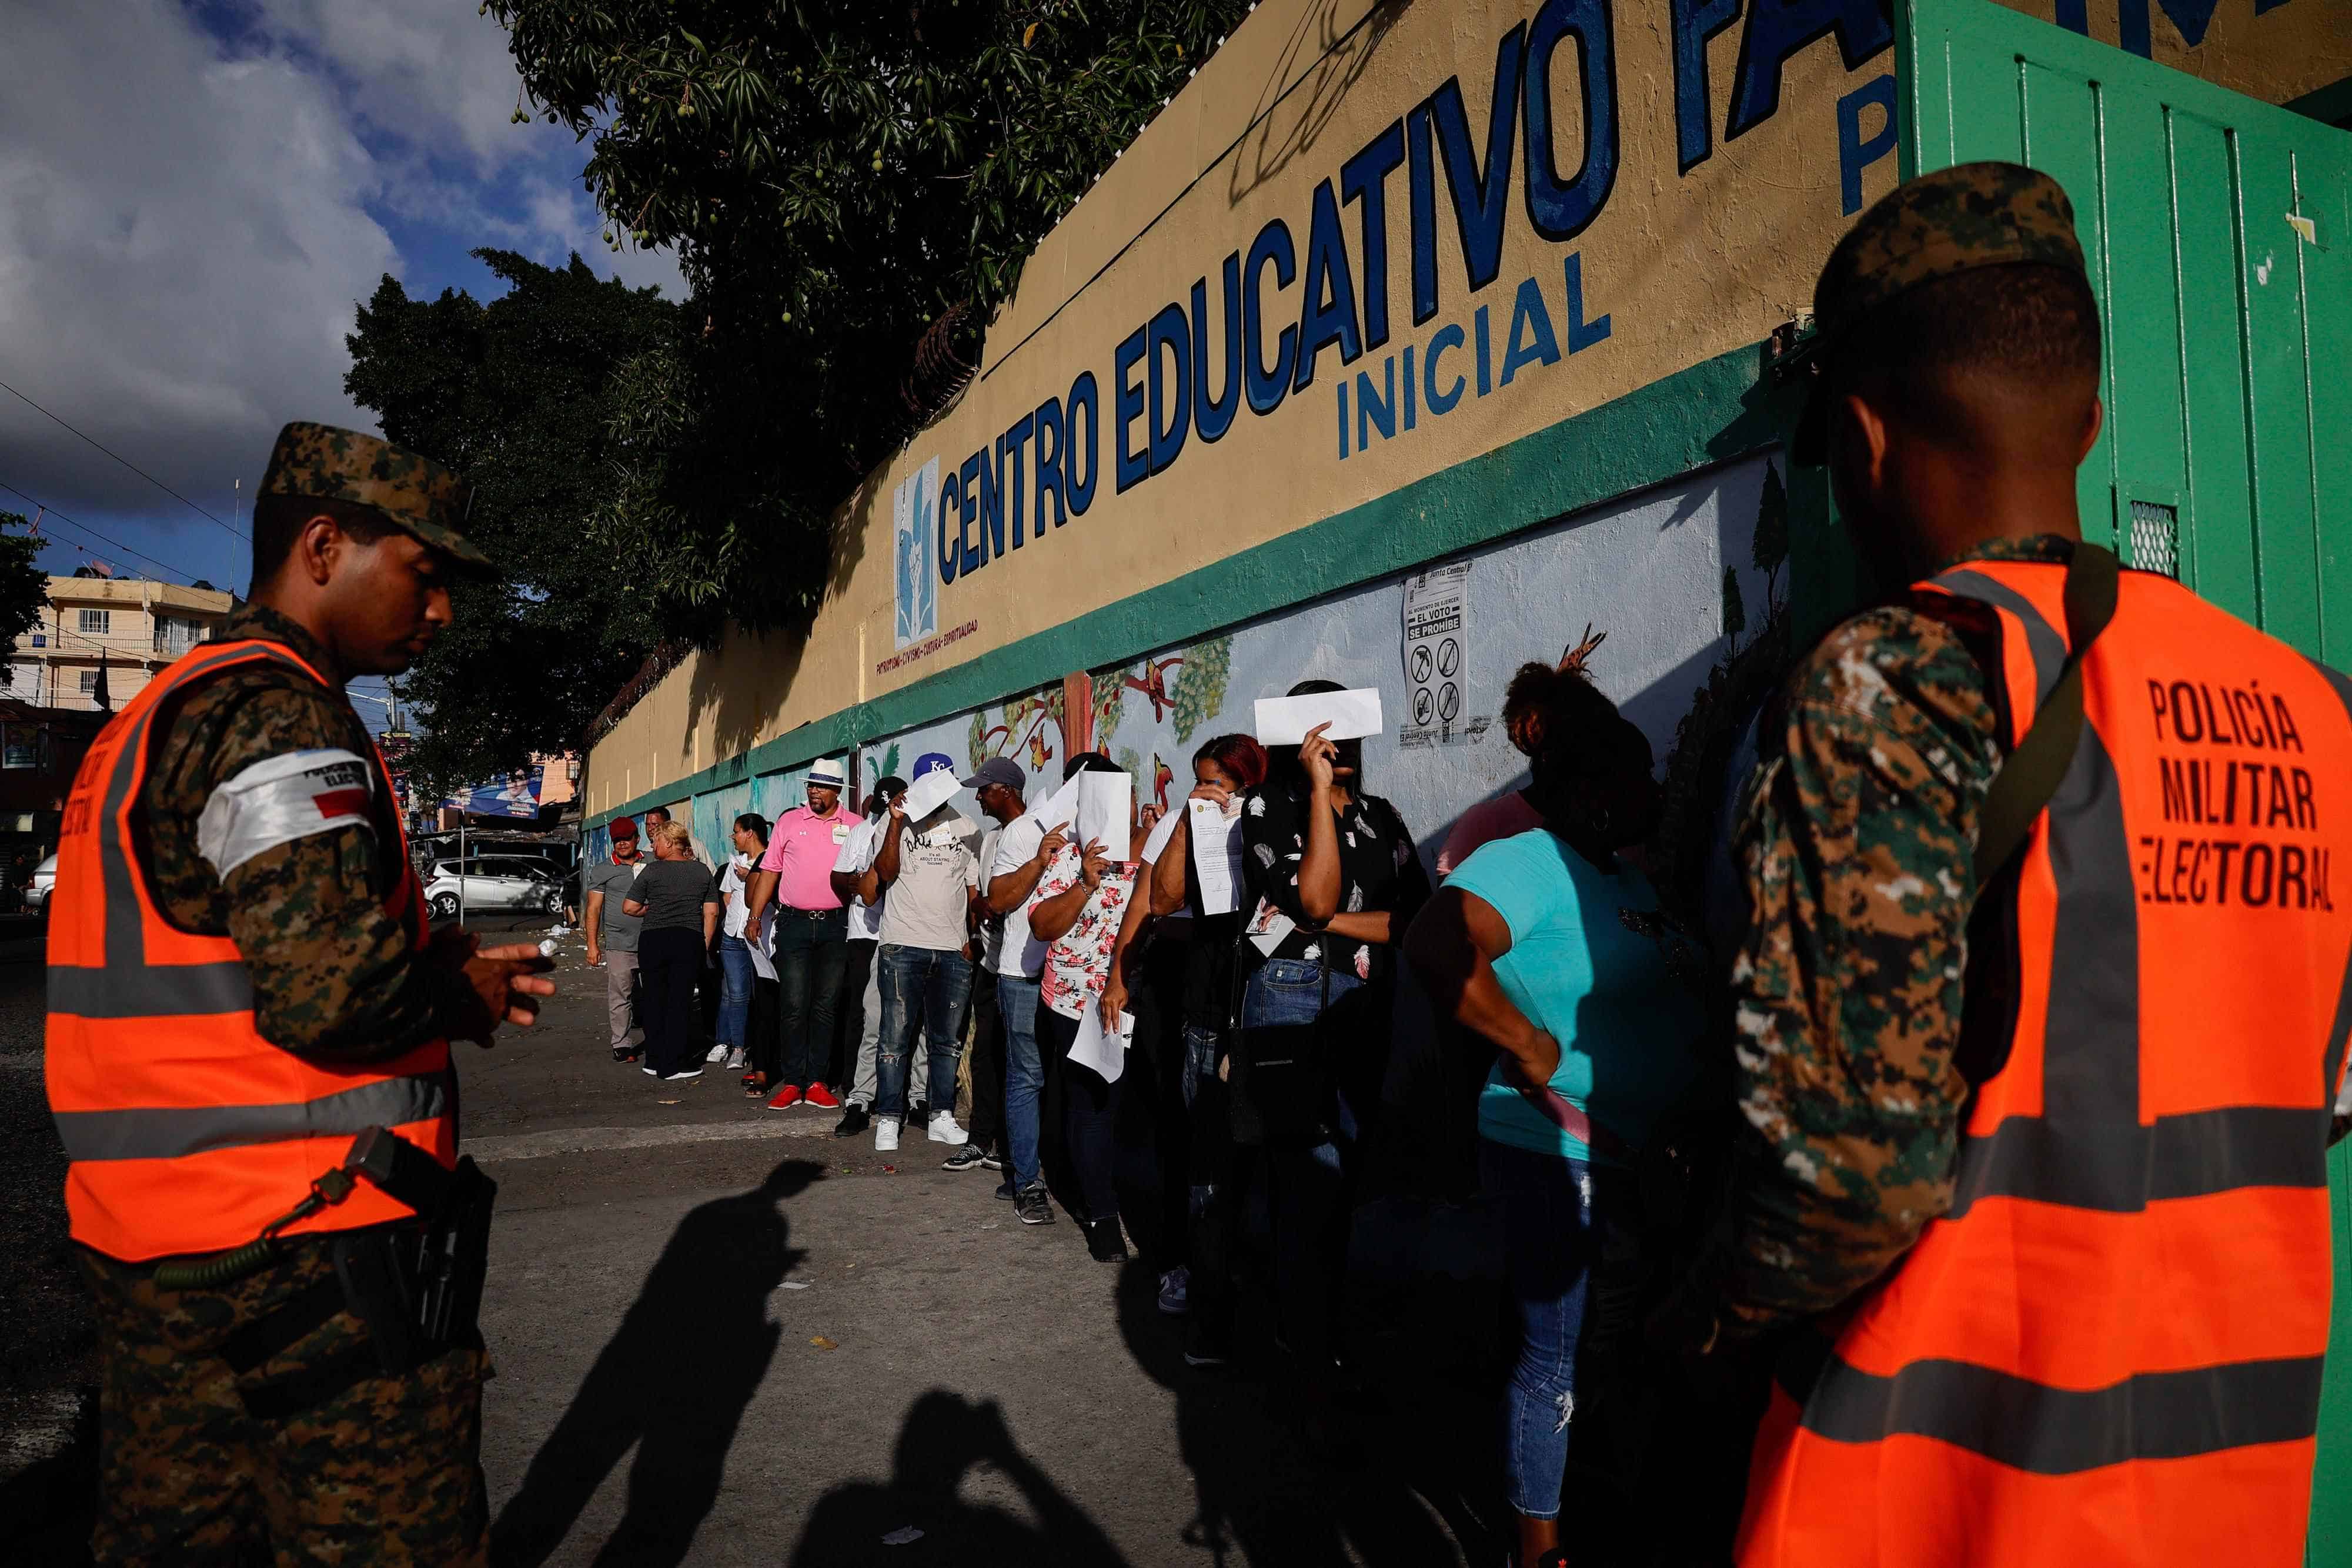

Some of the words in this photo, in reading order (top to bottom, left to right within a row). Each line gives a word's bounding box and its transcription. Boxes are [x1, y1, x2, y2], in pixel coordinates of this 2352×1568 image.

[938, 370, 1098, 586] CENTRO
[1115, 0, 1620, 496] EDUCATIVO
[1338, 251, 1611, 461] INICIAL
[1409, 627, 1421, 639] SE
[1422, 618, 1459, 636] PROHÍBE
[1414, 603, 1434, 613] MOMENTO
[1441, 596, 1459, 606] EJERCER
[1417, 613, 1427, 623] EL
[1429, 606, 1450, 620] VOTO
[2147, 677, 2304, 754] POLICÍA
[2159, 757, 2318, 833] MILITAR
[2140, 834, 2334, 912] ELECTORAL
